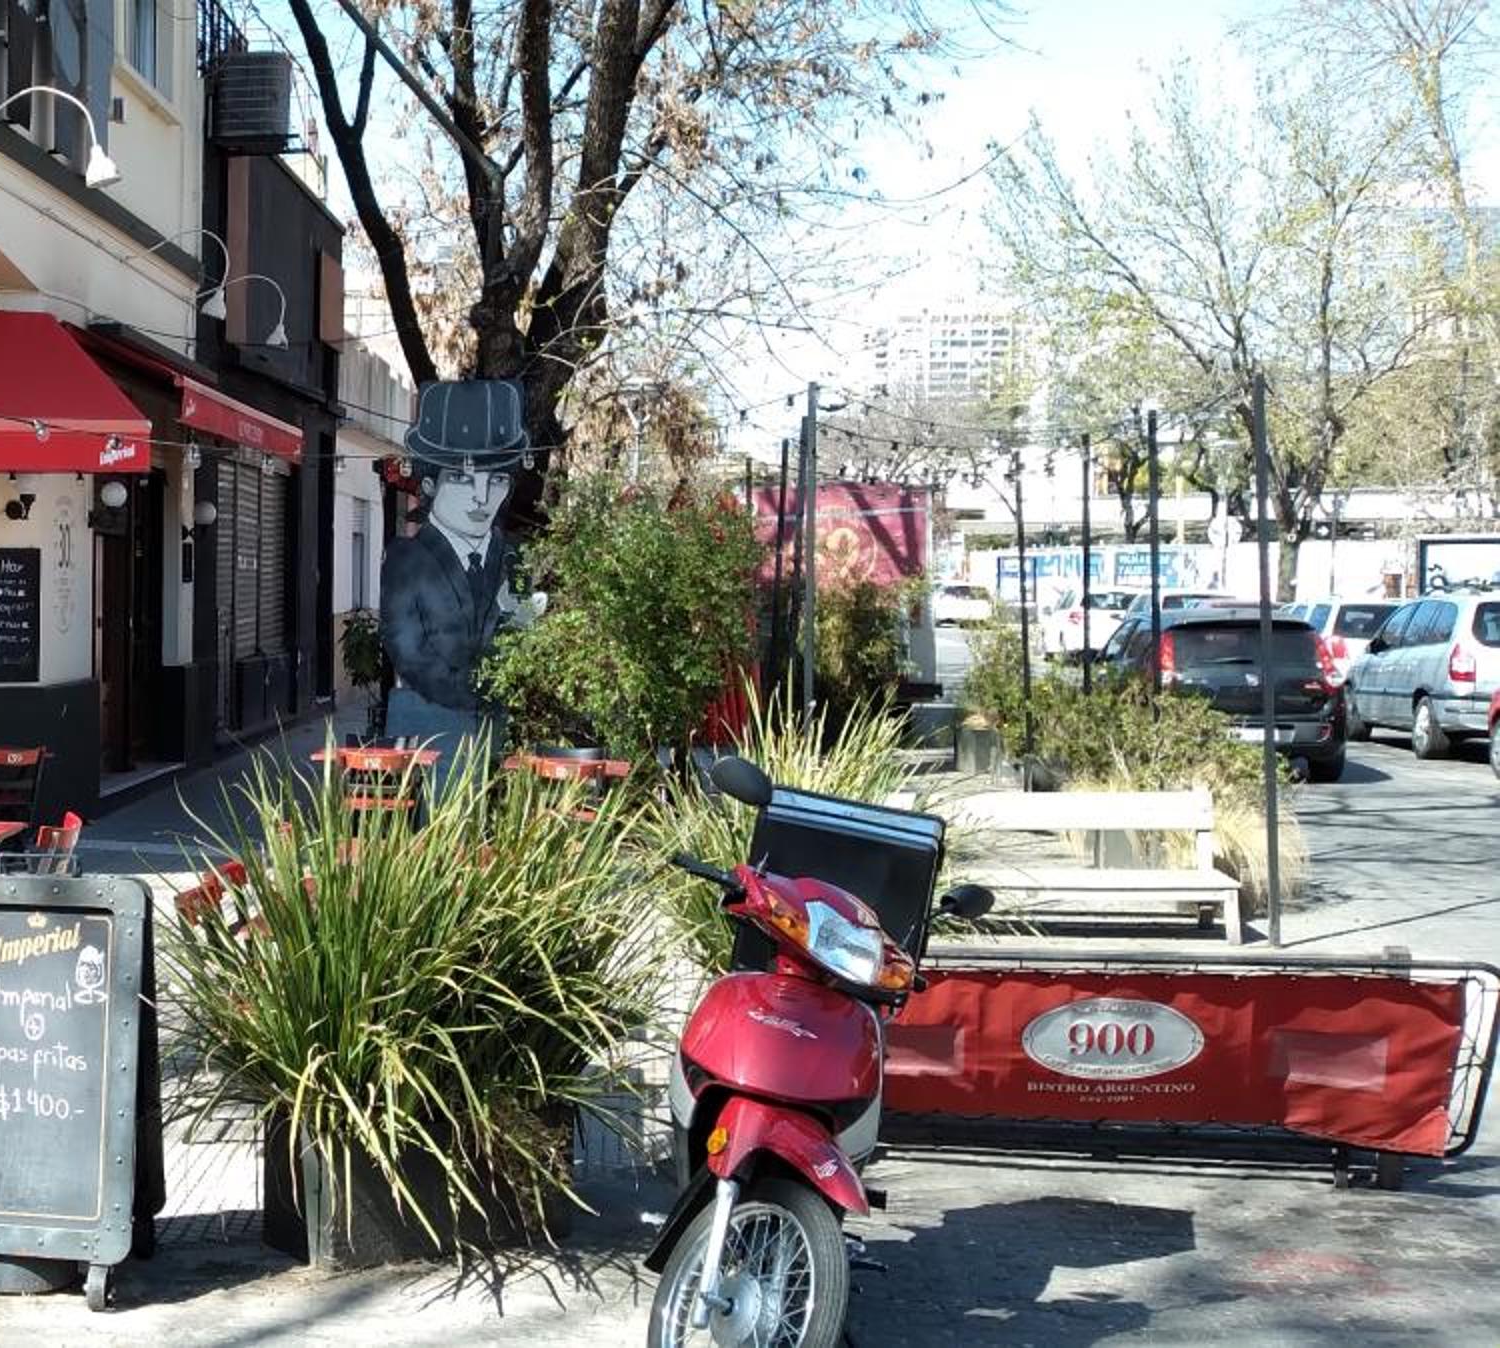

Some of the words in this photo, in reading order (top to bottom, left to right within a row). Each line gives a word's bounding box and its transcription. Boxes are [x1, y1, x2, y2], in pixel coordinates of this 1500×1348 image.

[1067, 1021, 1155, 1056] 900
[34, 1041, 87, 1081] fritas
[1027, 1081, 1090, 1093] BISTRO
[1093, 1081, 1196, 1094] ARGENTINO
